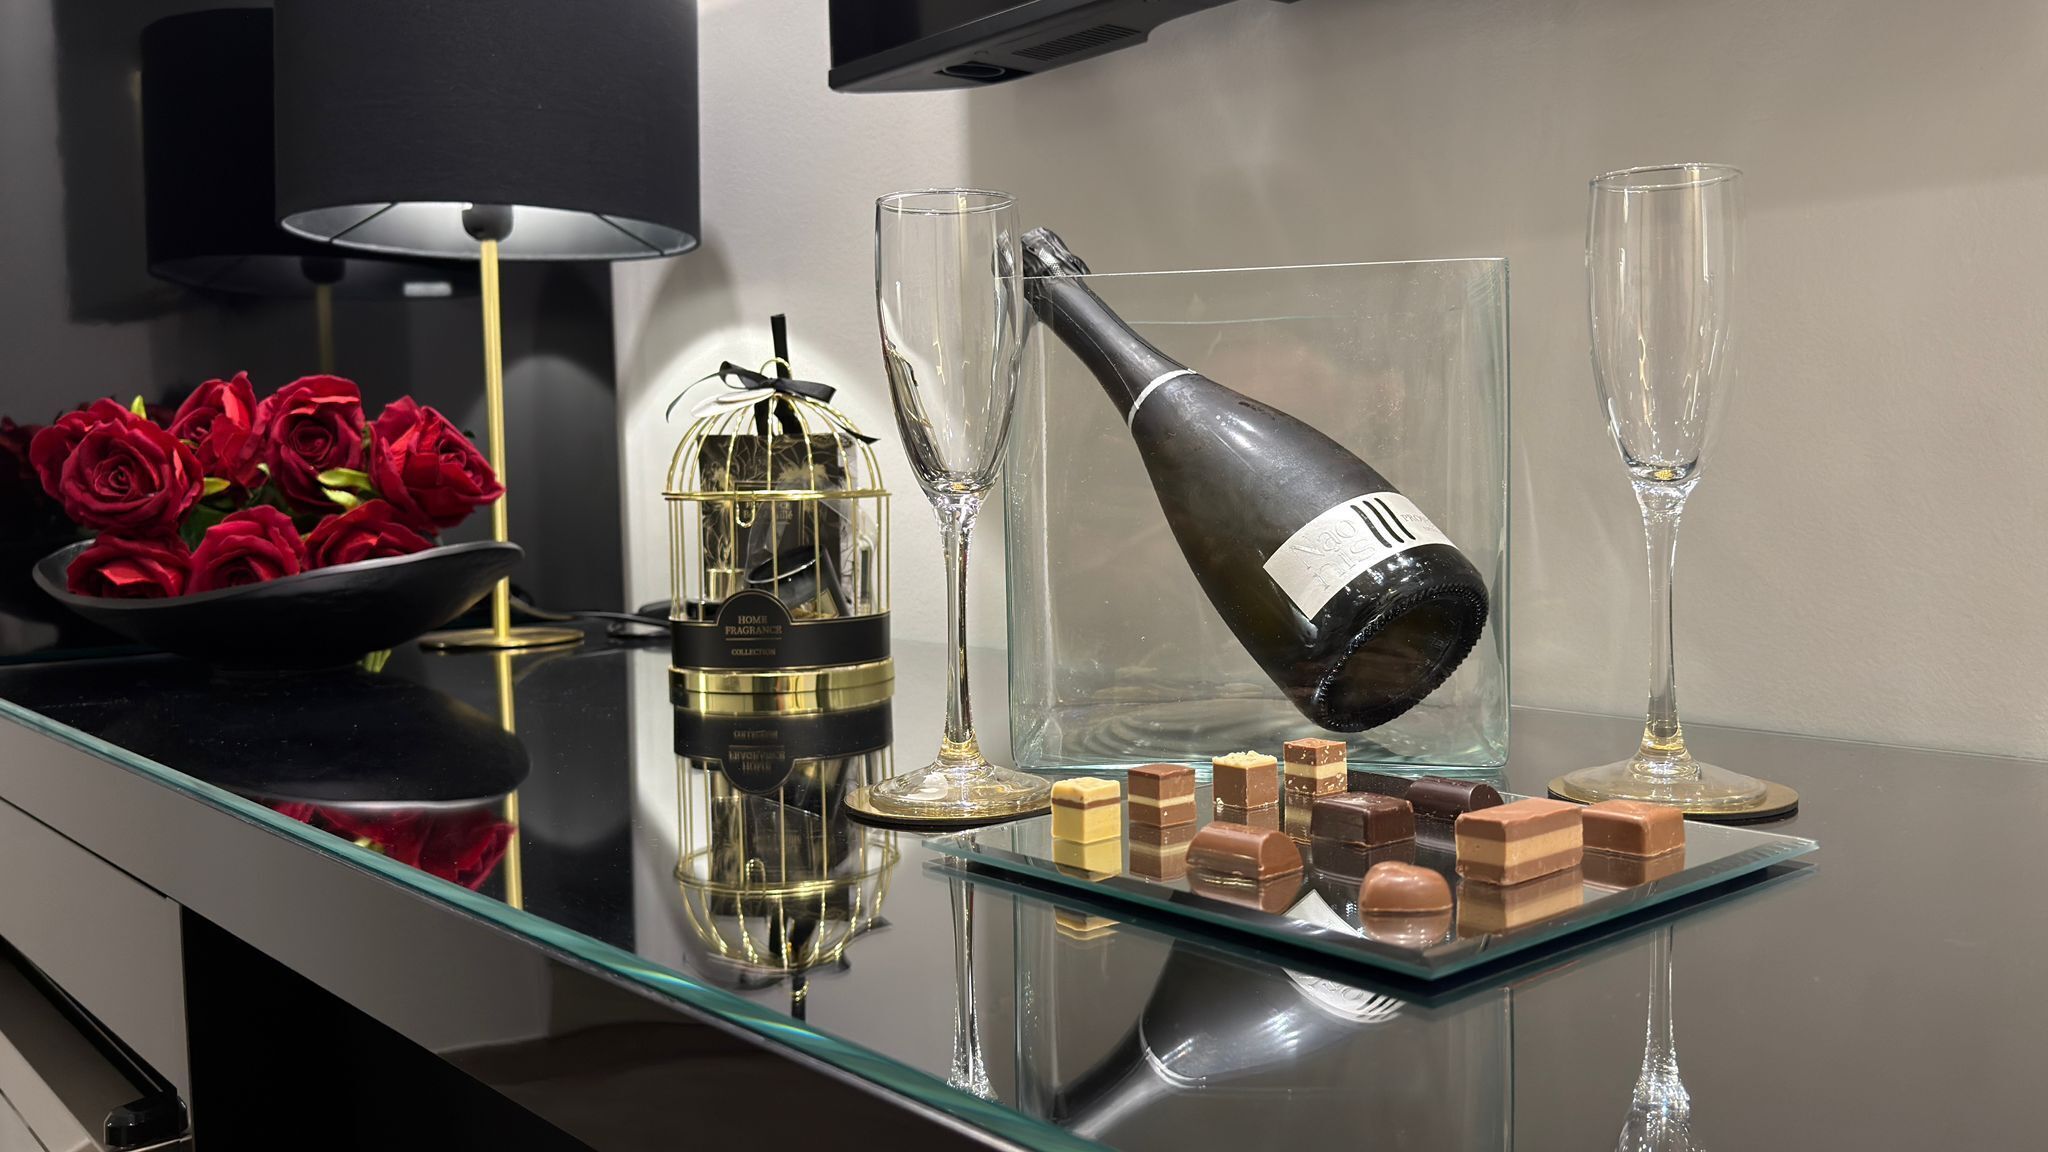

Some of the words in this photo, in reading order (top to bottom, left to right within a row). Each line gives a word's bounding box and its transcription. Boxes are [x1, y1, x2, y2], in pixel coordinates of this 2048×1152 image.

[738, 615, 768, 625] HOME
[725, 626, 784, 635] FRAGRANCE
[731, 648, 776, 656] COLLECTION
